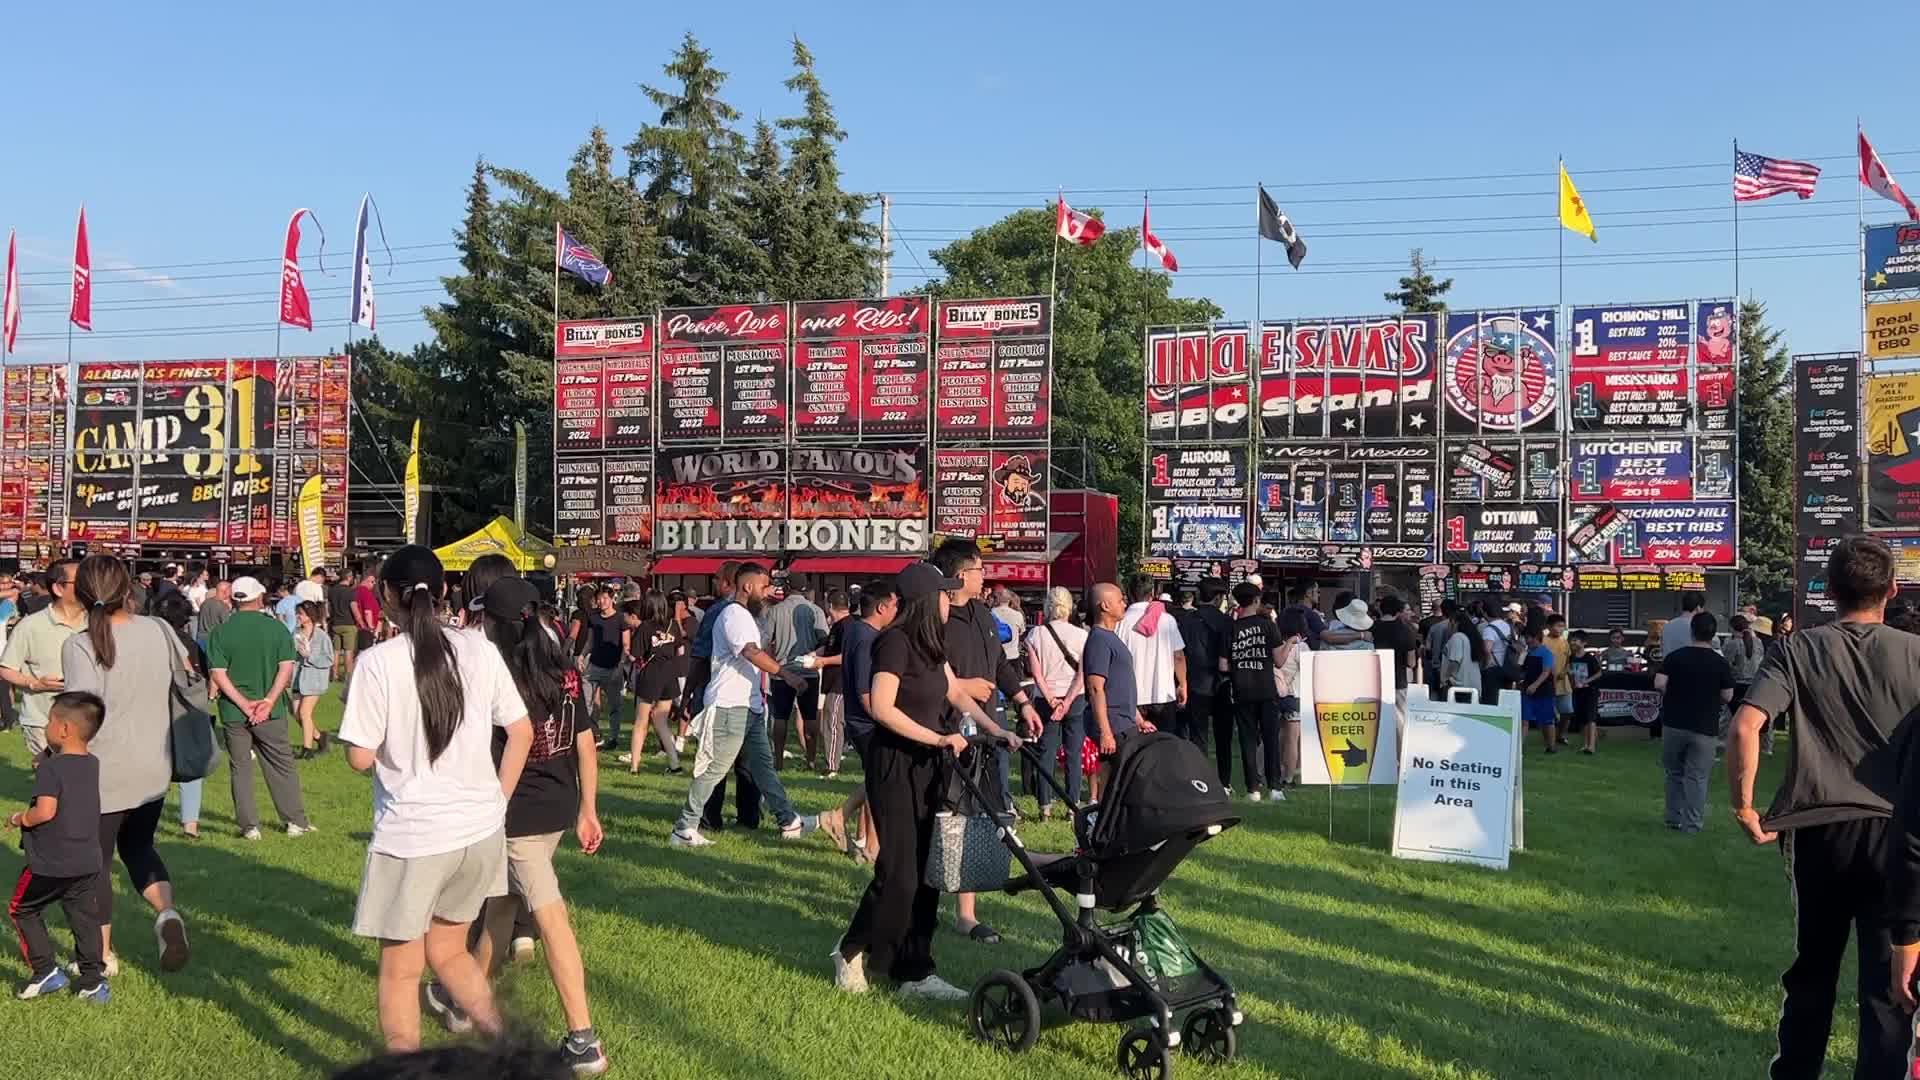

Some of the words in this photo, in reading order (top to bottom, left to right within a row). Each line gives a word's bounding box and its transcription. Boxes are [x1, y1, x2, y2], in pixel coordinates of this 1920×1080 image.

[801, 313, 846, 331] and
[853, 307, 919, 331] Ribs!
[947, 307, 986, 323] BILLY
[993, 304, 1039, 321] BONES
[667, 314, 730, 338] Peace,
[730, 310, 781, 336] Love
[1875, 312, 1913, 327] Real
[565, 327, 600, 342] BILLY
[604, 323, 643, 340] BONES
[1575, 319, 1598, 356] 1
[1602, 310, 1661, 323] RICHMOND
[1663, 309, 1687, 320] HILL
[1608, 327, 1627, 337] BEST
[1627, 327, 1646, 337] RIBS
[1657, 326, 1677, 336] 2022
[1869, 323, 1920, 340] TEXAS
[1657, 338, 1677, 347] 2016
[1878, 338, 1911, 351] BBQ
[864, 344, 925, 355] SUMMERSIDE
[998, 345, 1045, 356] COBOURG
[1151, 330, 1283, 389] UNCLE
[1290, 322, 1424, 371] SAM'S
[1608, 351, 1627, 361] BEST
[1627, 350, 1653, 361] SAUCE
[1657, 350, 1677, 360] 2022
[960, 361, 986, 370] Place
[84, 367, 167, 380] ALABAMA'S
[168, 367, 224, 378] FINEST
[1605, 375, 1678, 386] MISSISSAUGA
[1446, 355, 1477, 412] SIMPLY
[1483, 412, 1523, 425] THE
[1528, 376, 1556, 416] BEST
[1811, 382, 1844, 391] cobourg
[1613, 391, 1630, 401] BEST
[1630, 391, 1647, 401] RIBS
[1656, 390, 1674, 400] 2014
[1151, 402, 1249, 426] BBQ
[1262, 380, 1433, 417] Stand
[1609, 402, 1627, 412] BEST
[1627, 402, 1657, 412] CHICKEN
[743, 415, 767, 424] 2022
[814, 415, 839, 425] 2022
[882, 412, 907, 421] 2022
[950, 415, 977, 424] 2022
[1007, 415, 1034, 425] 2022
[1604, 415, 1623, 425] BEST
[1623, 414, 1643, 424] SAUCE
[75, 415, 181, 472] CAMP
[183, 376, 263, 478] 31
[679, 419, 703, 428] 2022
[617, 426, 640, 435] 2022
[1273, 446, 1339, 458] New
[1350, 448, 1430, 458] Mexico
[1579, 441, 1682, 456] KITCHENER
[937, 456, 988, 467] VANCOUVER
[1180, 451, 1231, 464] AURORA
[1619, 458, 1667, 468] BEST
[672, 450, 779, 484] WORLD
[790, 449, 917, 484] FAMOUS
[1613, 467, 1666, 476] SAUCE
[941, 472, 957, 481] 1ST
[958, 472, 985, 481] Place
[1610, 478, 1646, 487] Judge's
[1647, 477, 1680, 487] Choice
[231, 477, 272, 497] RIBS
[1621, 488, 1662, 497] 2018
[1494, 490, 1512, 498] 2015
[141, 492, 180, 508] DIXIE
[252, 504, 268, 519] #1
[1172, 505, 1242, 518] STOUFFVILLE
[1698, 507, 1729, 518] HILL
[1822, 505, 1853, 513] chicken
[1481, 511, 1539, 525] OTTAWA
[1645, 522, 1685, 533] BEST
[1687, 521, 1725, 532] RIBS
[617, 534, 640, 543] 2019
[661, 520, 772, 551] BILLY
[786, 519, 922, 551] BONES
[1473, 530, 1491, 541] BEST
[1491, 530, 1513, 541] SAUCE
[1534, 530, 1552, 540] 2022
[1648, 537, 1686, 547] Judge's
[1688, 536, 1723, 547] Choice
[1473, 543, 1503, 554] PEOPLES
[1504, 543, 1531, 554] CHOICE
[1534, 543, 1552, 553] 2016
[1654, 549, 1681, 558] 2016
[1688, 549, 1716, 558] 2017
[1237, 626, 1261, 640] ANTI
[1232, 637, 1267, 650] SOCIAL
[1231, 648, 1267, 660] SOCIAL
[1238, 660, 1264, 671] CLUB
[1318, 711, 1340, 721] ICE
[1342, 711, 1377, 722] COLD
[1331, 724, 1365, 735] BEER
[1412, 757, 1435, 770] No
[1439, 759, 1503, 778] Seating
[1430, 776, 1448, 788] in
[1450, 777, 1481, 792] this
[1434, 794, 1473, 809] Area
